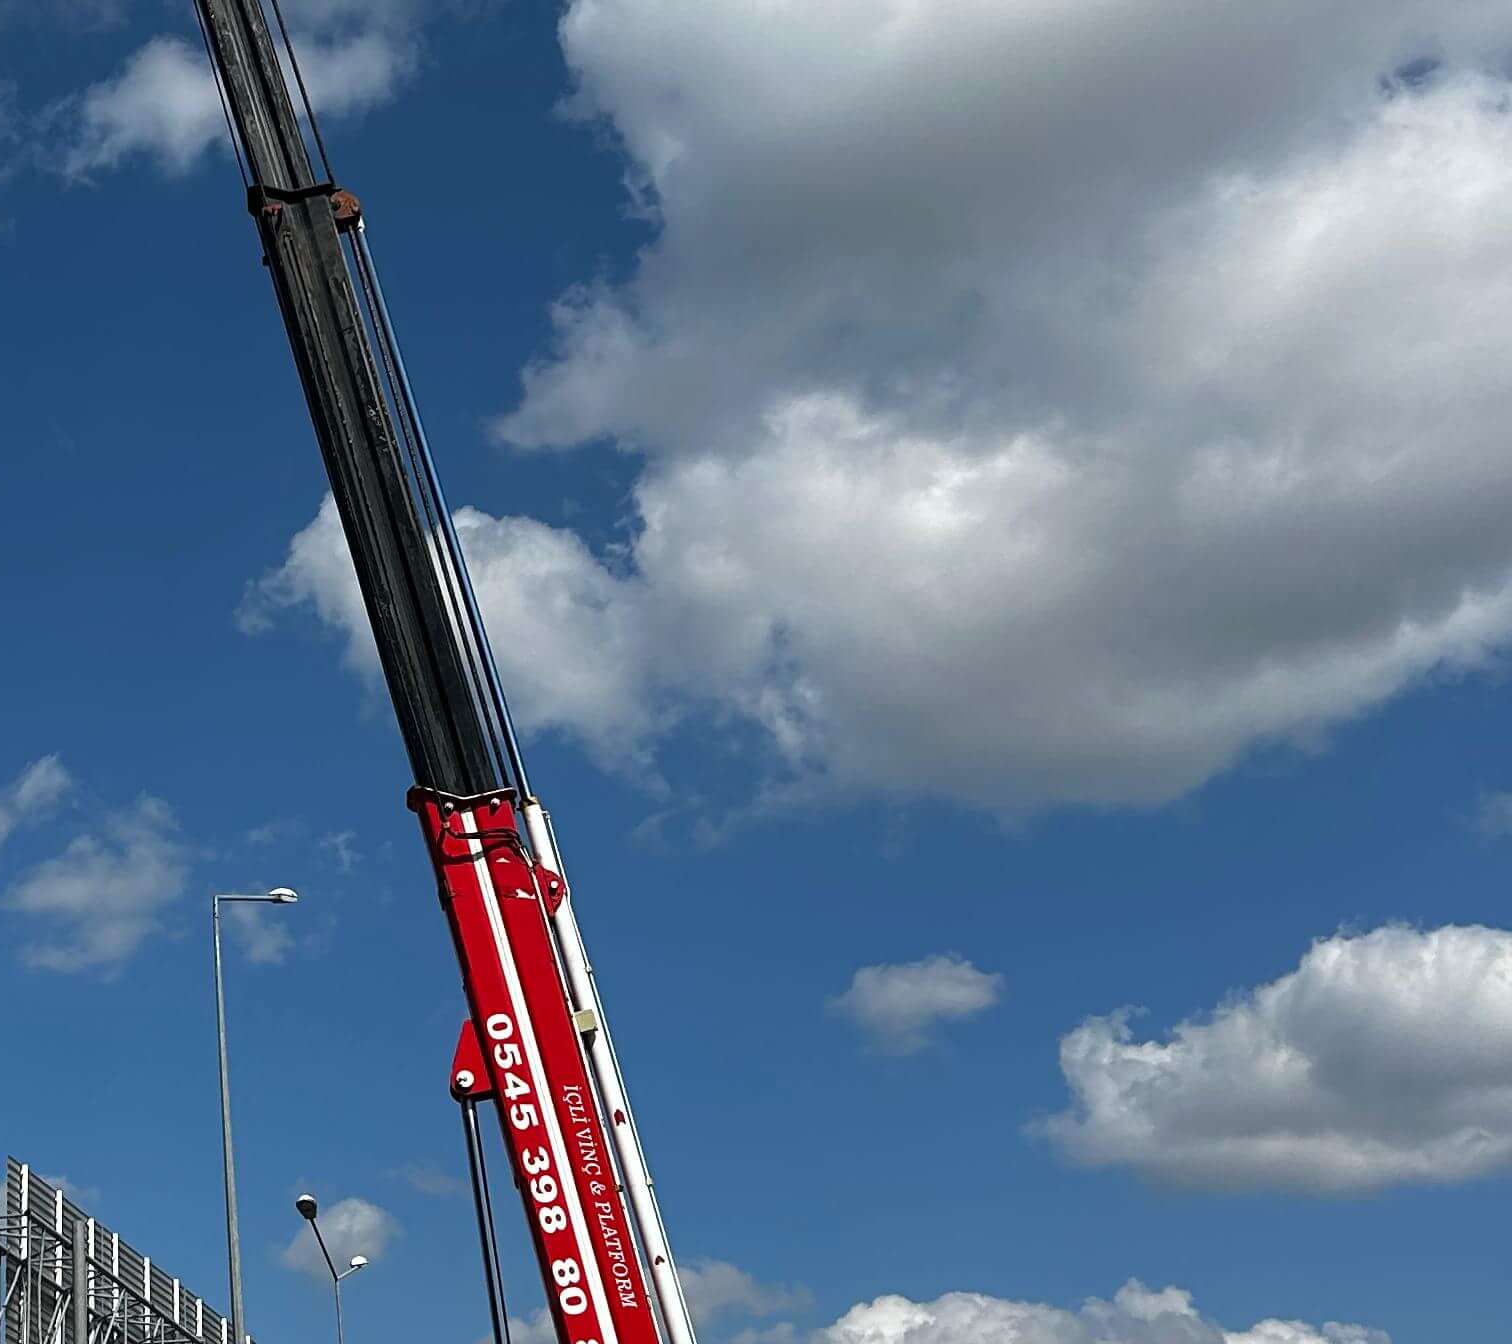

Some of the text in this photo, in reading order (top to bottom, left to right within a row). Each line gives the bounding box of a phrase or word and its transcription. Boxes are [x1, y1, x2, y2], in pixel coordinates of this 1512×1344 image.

[487, 1013, 539, 1130] 0545
[523, 1146, 567, 1234] 398
[553, 1258, 588, 1315] 80
[563, 1084, 638, 1309] İÇLİ VİNÇ & PLATFORM
